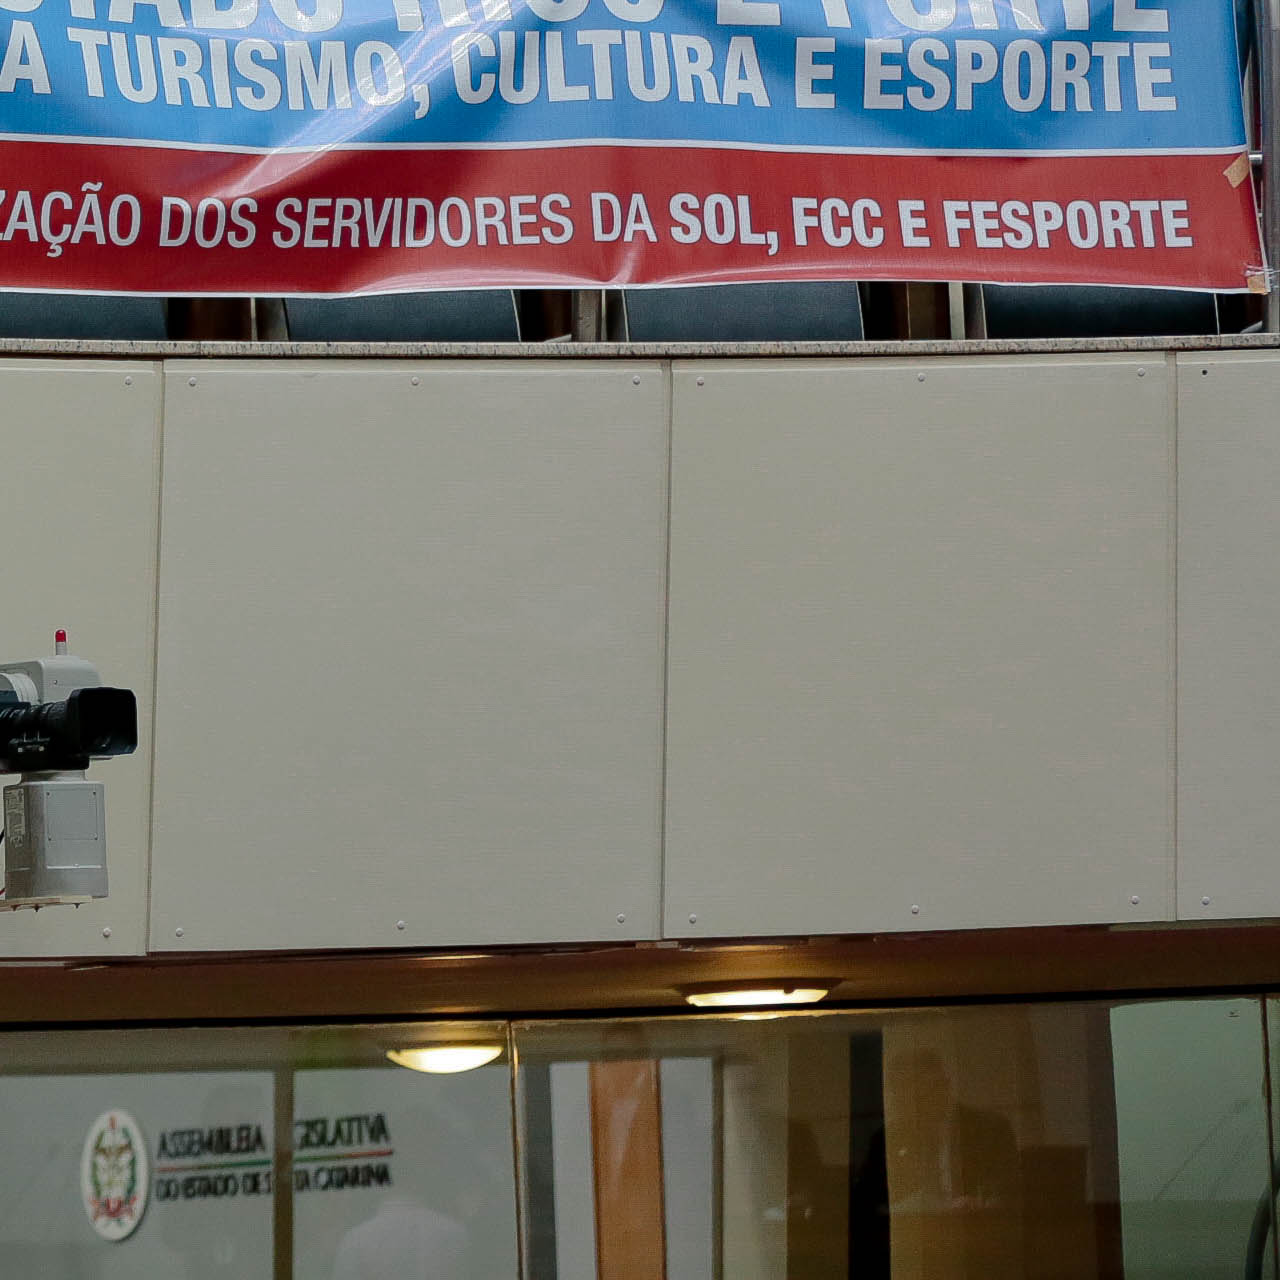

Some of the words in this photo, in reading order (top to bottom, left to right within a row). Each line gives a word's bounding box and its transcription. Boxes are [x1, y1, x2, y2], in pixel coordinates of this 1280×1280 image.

[66, 26, 431, 120] TURISMO,
[451, 30, 771, 108] CULTURA
[795, 36, 836, 109] E
[863, 37, 1177, 112] ESPORTE
[159, 196, 257, 248] DOS
[272, 192, 575, 249] SERVIDORES
[591, 192, 658, 244] DA
[670, 193, 779, 256] SOL,
[791, 197, 885, 248] FCC
[897, 199, 932, 248] E
[942, 199, 1193, 249] FESPORTE
